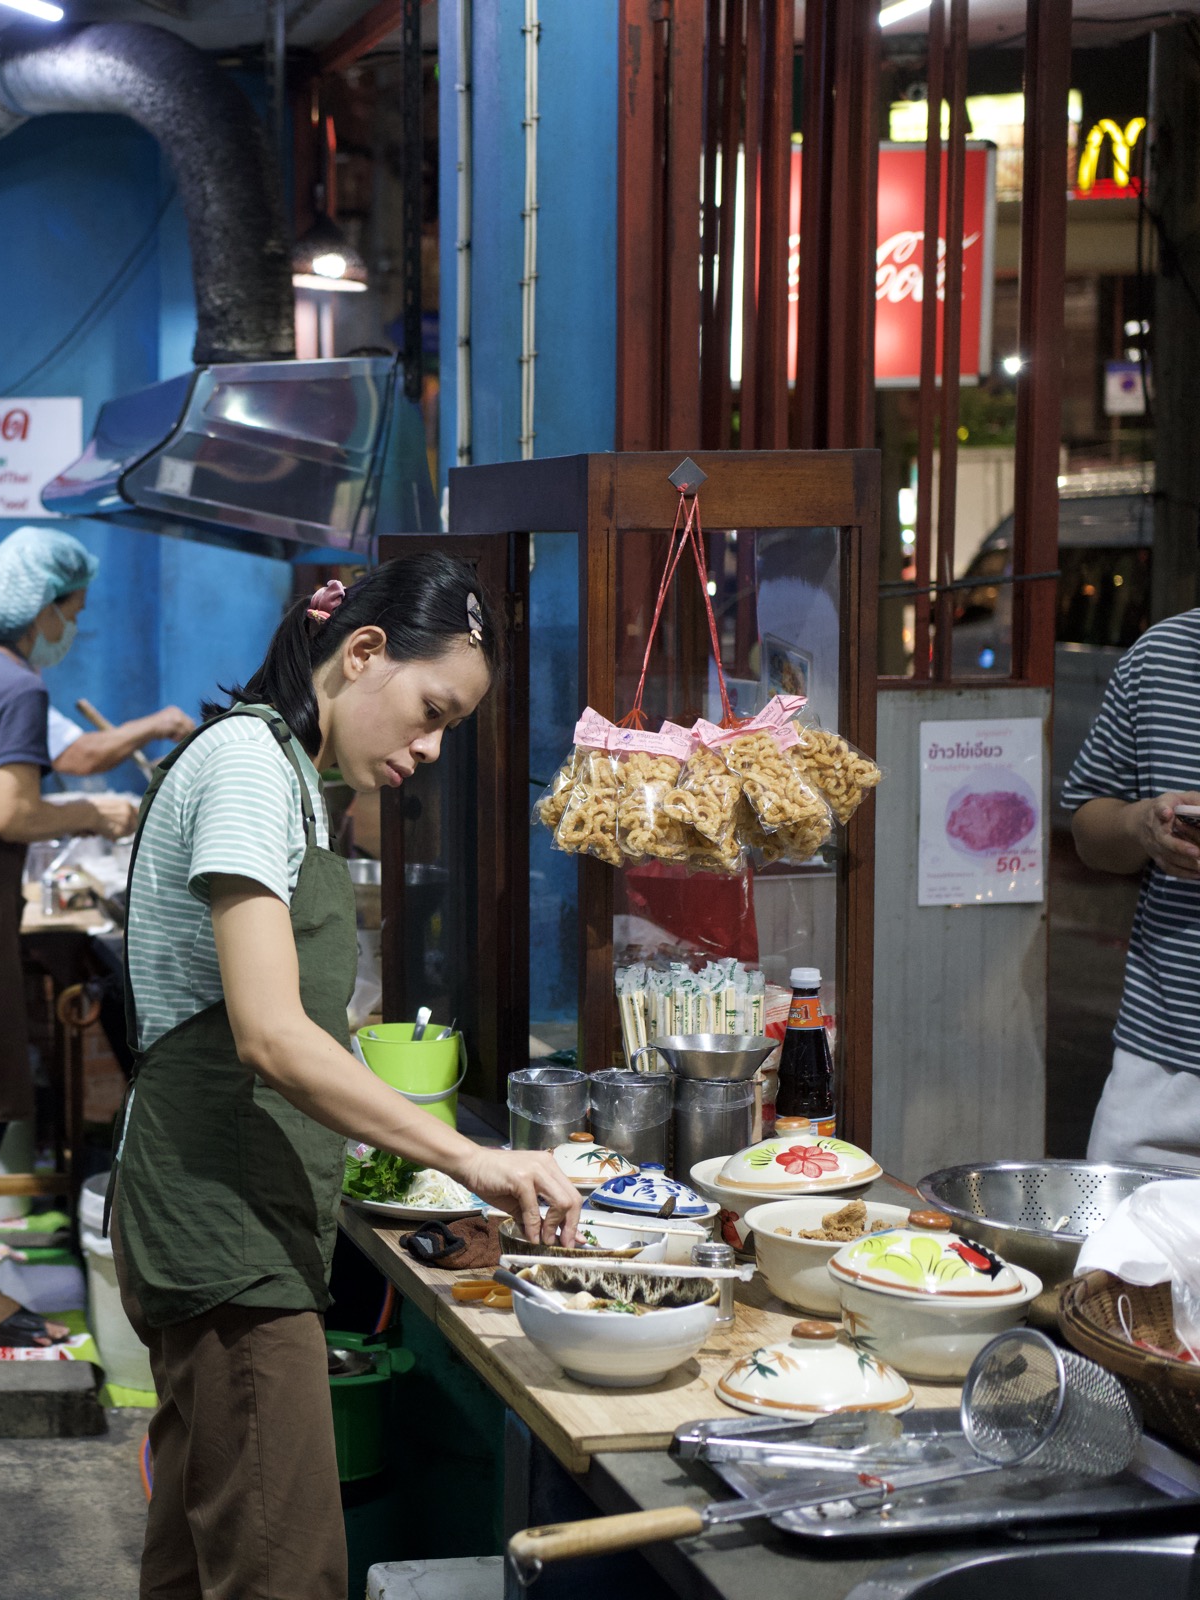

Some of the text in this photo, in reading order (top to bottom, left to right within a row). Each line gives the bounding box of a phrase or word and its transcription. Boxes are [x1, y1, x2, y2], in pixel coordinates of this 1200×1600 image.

[928, 741, 1003, 760] ข้าวไข่เจียว
